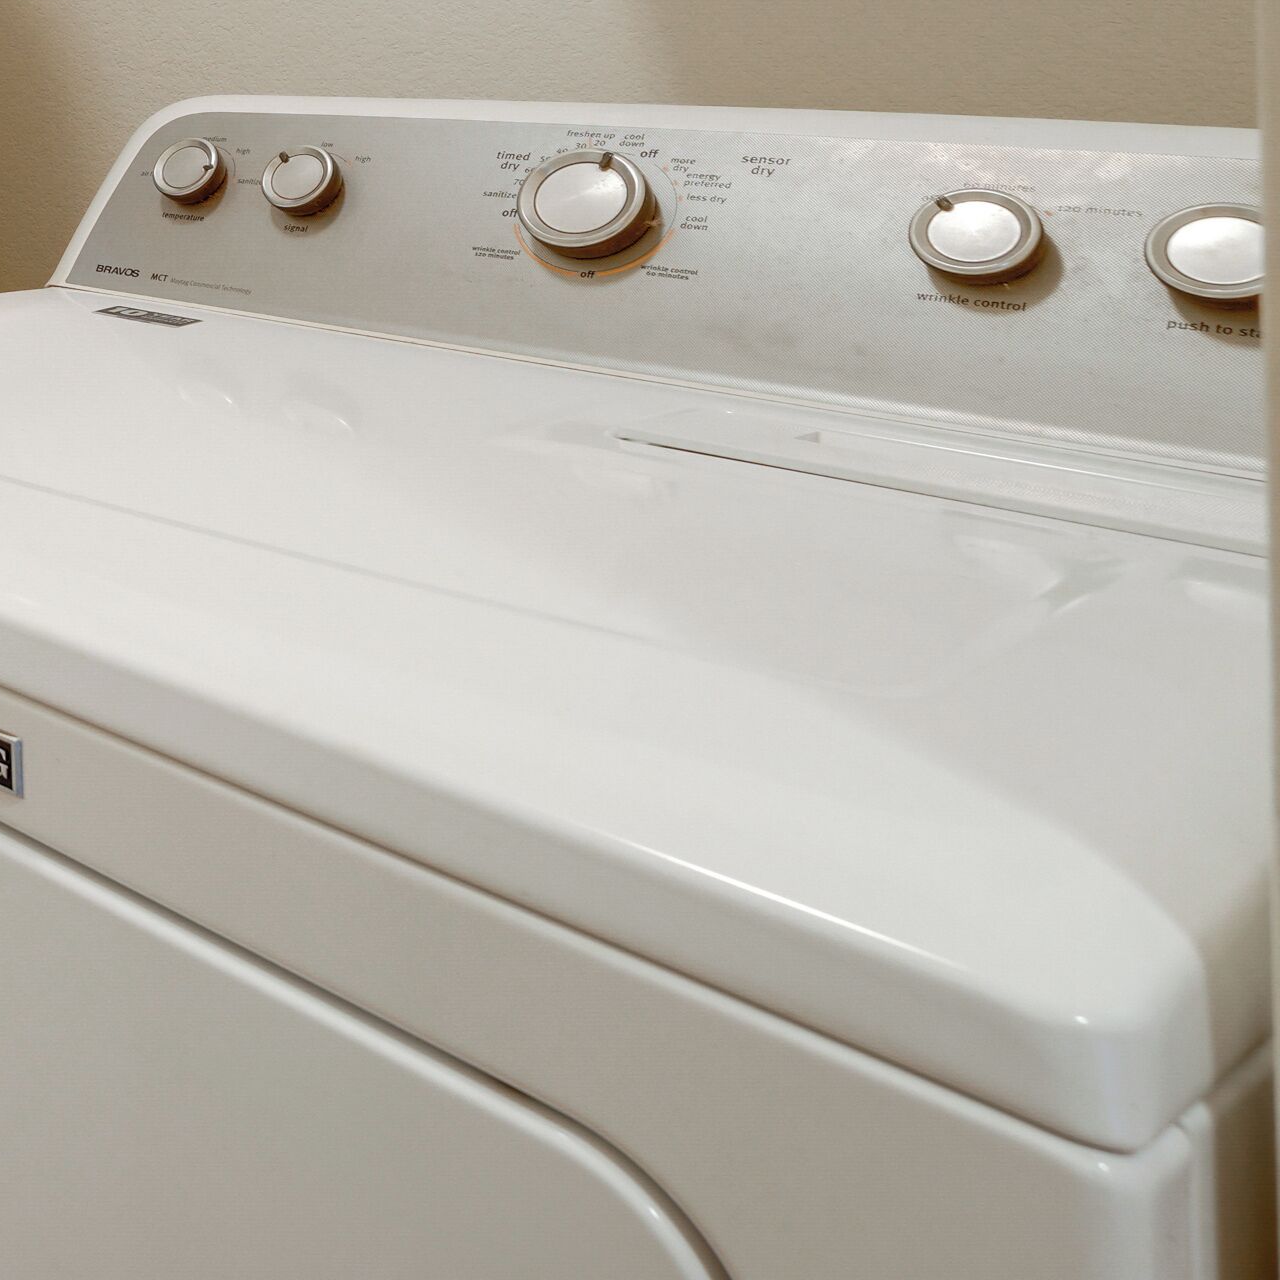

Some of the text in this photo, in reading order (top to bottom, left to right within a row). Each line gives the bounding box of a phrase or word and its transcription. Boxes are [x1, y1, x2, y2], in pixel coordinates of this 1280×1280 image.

[567, 130, 602, 138] freshen
[321, 141, 334, 149] low
[619, 140, 645, 148] down
[236, 147, 251, 156] high
[496, 151, 531, 161] timed
[640, 149, 659, 158] off
[355, 155, 372, 164] high
[742, 155, 792, 166] sensor
[500, 161, 520, 171] dry
[673, 164, 689, 173] dry
[686, 172, 722, 181] energy
[751, 166, 776, 177] dry
[683, 180, 733, 190] preferred
[483, 190, 517, 199] sanitize
[687, 194, 728, 205] less dry
[502, 208, 519, 218] off
[1057, 205, 1144, 218] 120 minutes
[162, 212, 205, 223] temperature
[283, 224, 309, 234] signal
[680, 223, 709, 231] down
[472, 246, 521, 256] wrinkle control
[487, 253, 515, 261] minutes
[580, 271, 596, 279] off
[640, 264, 699, 276] wrinkle control
[96, 264, 141, 278] BRAVOS
[151, 273, 169, 282] MCT
[190, 280, 221, 290] Commercial
[221, 284, 253, 295] Technology
[658, 272, 690, 281] minutes
[917, 292, 1028, 312] wrinkle control
[1166, 321, 1210, 334] push
[1215, 323, 1233, 335] to
